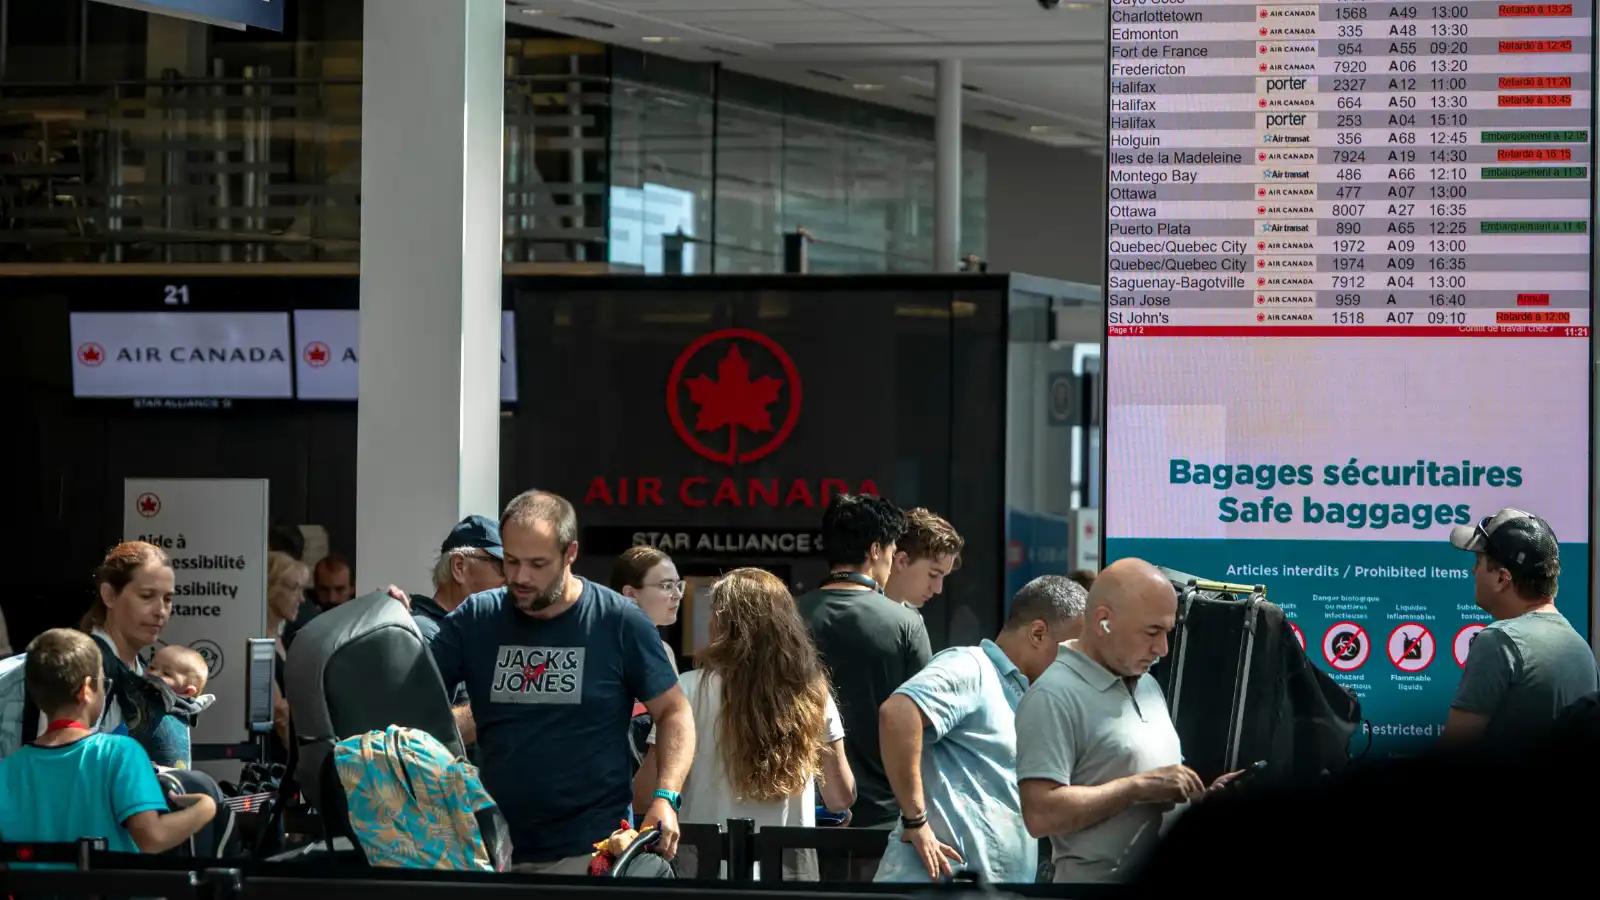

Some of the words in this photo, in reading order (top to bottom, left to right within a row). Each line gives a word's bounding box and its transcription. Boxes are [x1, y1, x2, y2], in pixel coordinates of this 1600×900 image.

[1112, 11, 1203, 22] Charlottetown
[1336, 8, 1367, 19] 1568
[1432, 6, 1468, 17] 13:00
[1112, 29, 1179, 40] Edmonton
[1338, 26, 1363, 37] 335
[1431, 24, 1467, 36] 13:30
[1112, 47, 1138, 58] Fort
[1142, 47, 1158, 58] de
[1163, 47, 1208, 58] France
[1338, 44, 1361, 55] 954
[1431, 42, 1467, 53] 09:20
[1112, 64, 1186, 76] Fredericton
[1334, 61, 1366, 72] 7920
[1431, 60, 1467, 72] 13:20
[1112, 82, 1156, 94] Halifax
[1267, 77, 1306, 92] porter
[1334, 79, 1365, 91] 2327
[1432, 78, 1466, 89] 11:00
[1111, 100, 1156, 111] Halifax
[1338, 97, 1361, 108] 664
[1431, 96, 1467, 107] 13:30
[1111, 118, 1156, 129] Halifax
[1267, 113, 1306, 128] porter
[1337, 115, 1361, 126] 253
[1431, 114, 1467, 125] 15:10
[1111, 136, 1160, 149] Holguin
[1337, 133, 1361, 144] 356
[1431, 132, 1467, 143] 12:45
[1111, 153, 1133, 165] Iles
[1137, 153, 1153, 165] de
[1159, 153, 1169, 165] la
[1174, 153, 1242, 165] Madeleine
[1333, 151, 1365, 162] 7924
[1431, 150, 1466, 161] 14:30
[1110, 171, 1168, 184] Montego
[1172, 171, 1197, 184] Bay
[1337, 169, 1361, 180] 486
[1430, 168, 1466, 180] 12:10
[1110, 189, 1157, 200] Ottawa
[1336, 187, 1361, 198] 477
[1431, 186, 1466, 197] 13:00
[1110, 207, 1157, 218] Ottawa
[1332, 204, 1365, 216] 8007
[1430, 204, 1466, 216] 16:35
[1110, 225, 1153, 236] Puerto
[1158, 225, 1191, 236] Plata
[1337, 223, 1360, 234] 890
[1430, 222, 1466, 233] 12:25
[1110, 242, 1218, 254] Quebec/Quebec
[1221, 242, 1247, 255] City
[1333, 240, 1365, 252] 1972
[1430, 240, 1466, 252] 13:00
[1110, 260, 1218, 272] Quebec/Quebec
[1221, 260, 1247, 273] City
[1333, 258, 1364, 270] 1974
[1429, 258, 1465, 269] 16:35
[1109, 278, 1245, 291] Saguenay-Bagotville
[1332, 276, 1364, 288] 7912
[1429, 276, 1465, 288] 13:00
[164, 284, 190, 305] 21
[1109, 296, 1135, 307] San
[1140, 296, 1171, 307] Jose
[1336, 294, 1360, 305] 959
[1387, 294, 1396, 304] A
[1429, 294, 1465, 305] 16:40
[1109, 314, 1123, 325] St
[1127, 314, 1170, 325] John's
[1333, 312, 1364, 323] 1518
[1428, 312, 1465, 324] 09:10
[1110, 326, 1128, 335] Page
[1565, 328, 1588, 336] 11:21
[117, 348, 162, 362] AIR
[170, 347, 286, 362] CANADA
[1169, 459, 1314, 491] Bagages
[1322, 457, 1523, 488] sécuritaires
[584, 476, 665, 507] AIR
[678, 476, 880, 508] CANADA
[1218, 496, 1293, 524] Safe
[1303, 497, 1471, 529] baggages
[176, 533, 186, 549] à
[632, 531, 691, 550] STAR
[696, 532, 811, 553] ALLIANCE
[172, 554, 245, 570] essibilité
[1226, 563, 1279, 577] Articles
[1282, 563, 1340, 578] interdits
[1343, 563, 1351, 579] /
[1355, 565, 1427, 579] Prohibited
[1430, 566, 1469, 579] items
[174, 581, 238, 600] ssibility
[1312, 594, 1339, 602] Danger
[1341, 594, 1380, 603] biologique
[1395, 604, 1427, 612] Liquides
[494, 672, 577, 694] JONES
[1391, 674, 1432, 682] Flammable
[1398, 682, 1424, 691] liquids
[1362, 723, 1433, 736] Restricted
